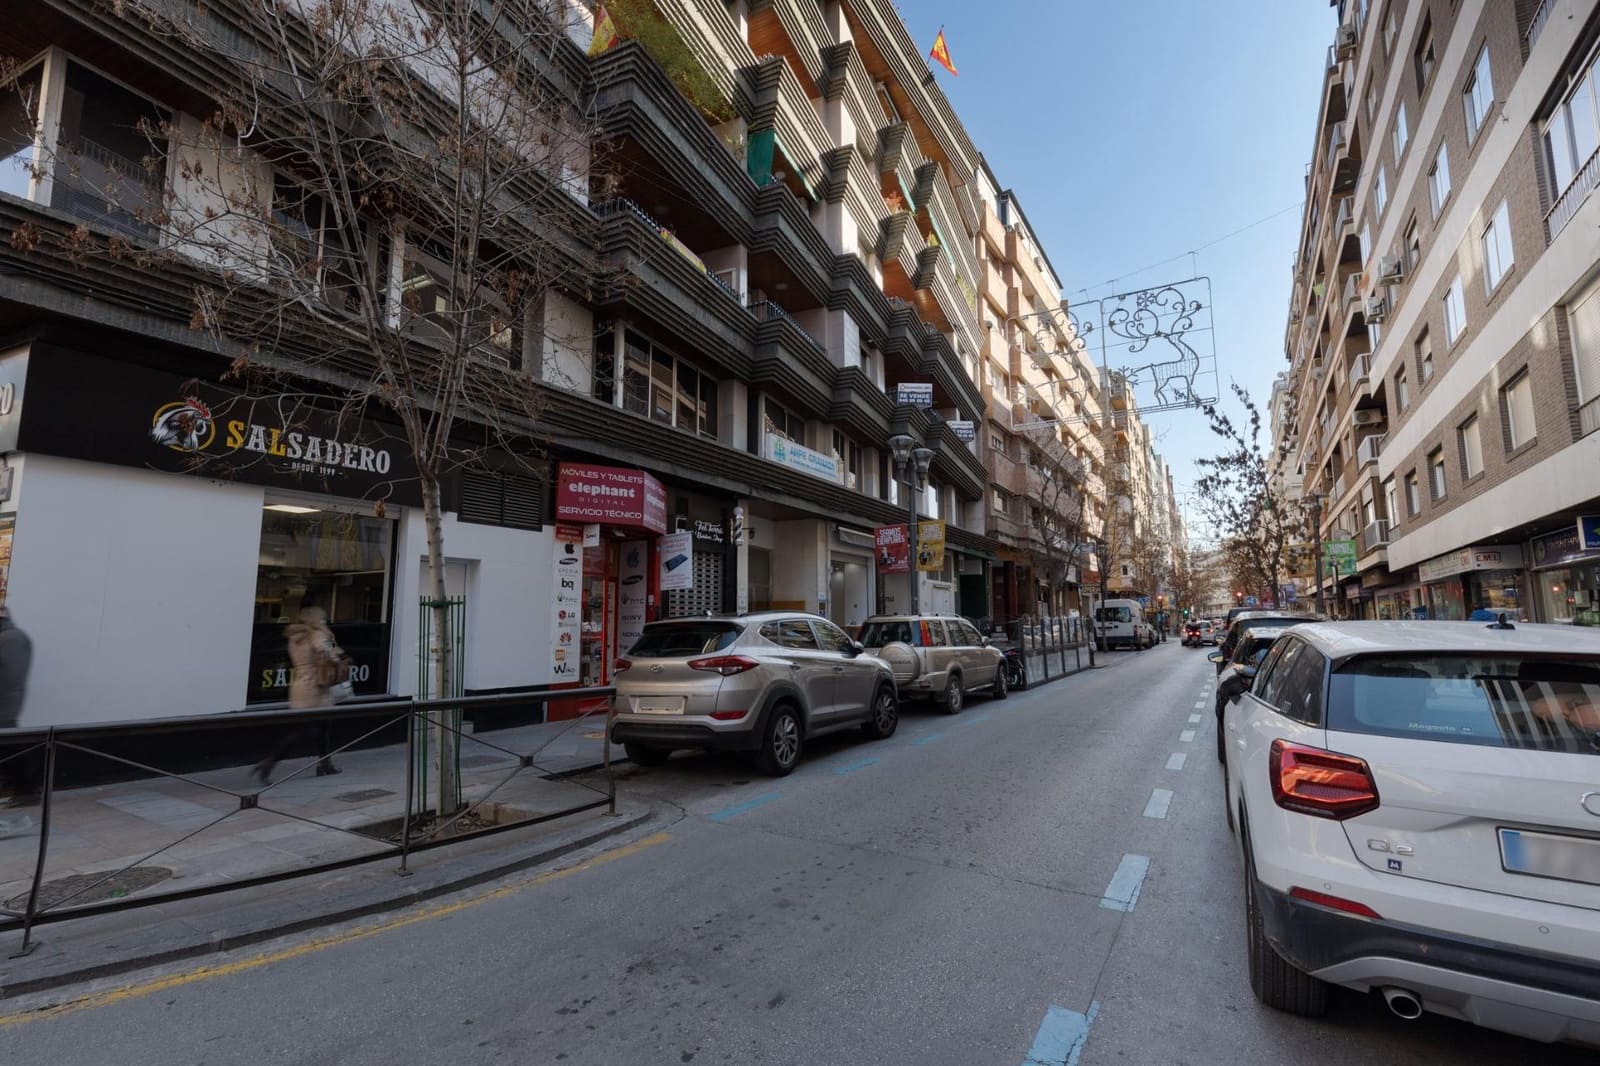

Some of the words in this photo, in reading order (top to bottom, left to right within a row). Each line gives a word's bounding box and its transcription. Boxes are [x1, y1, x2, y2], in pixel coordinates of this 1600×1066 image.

[226, 419, 391, 474] SALSADERO
[319, 466, 336, 476] 1999
[608, 473, 643, 484] TABLETS
[569, 482, 636, 498] elephant
[579, 497, 624, 506] DIGITAL
[559, 506, 603, 516] SERVICIO
[561, 578, 574, 590] bq
[1367, 838, 1415, 857] Q2
